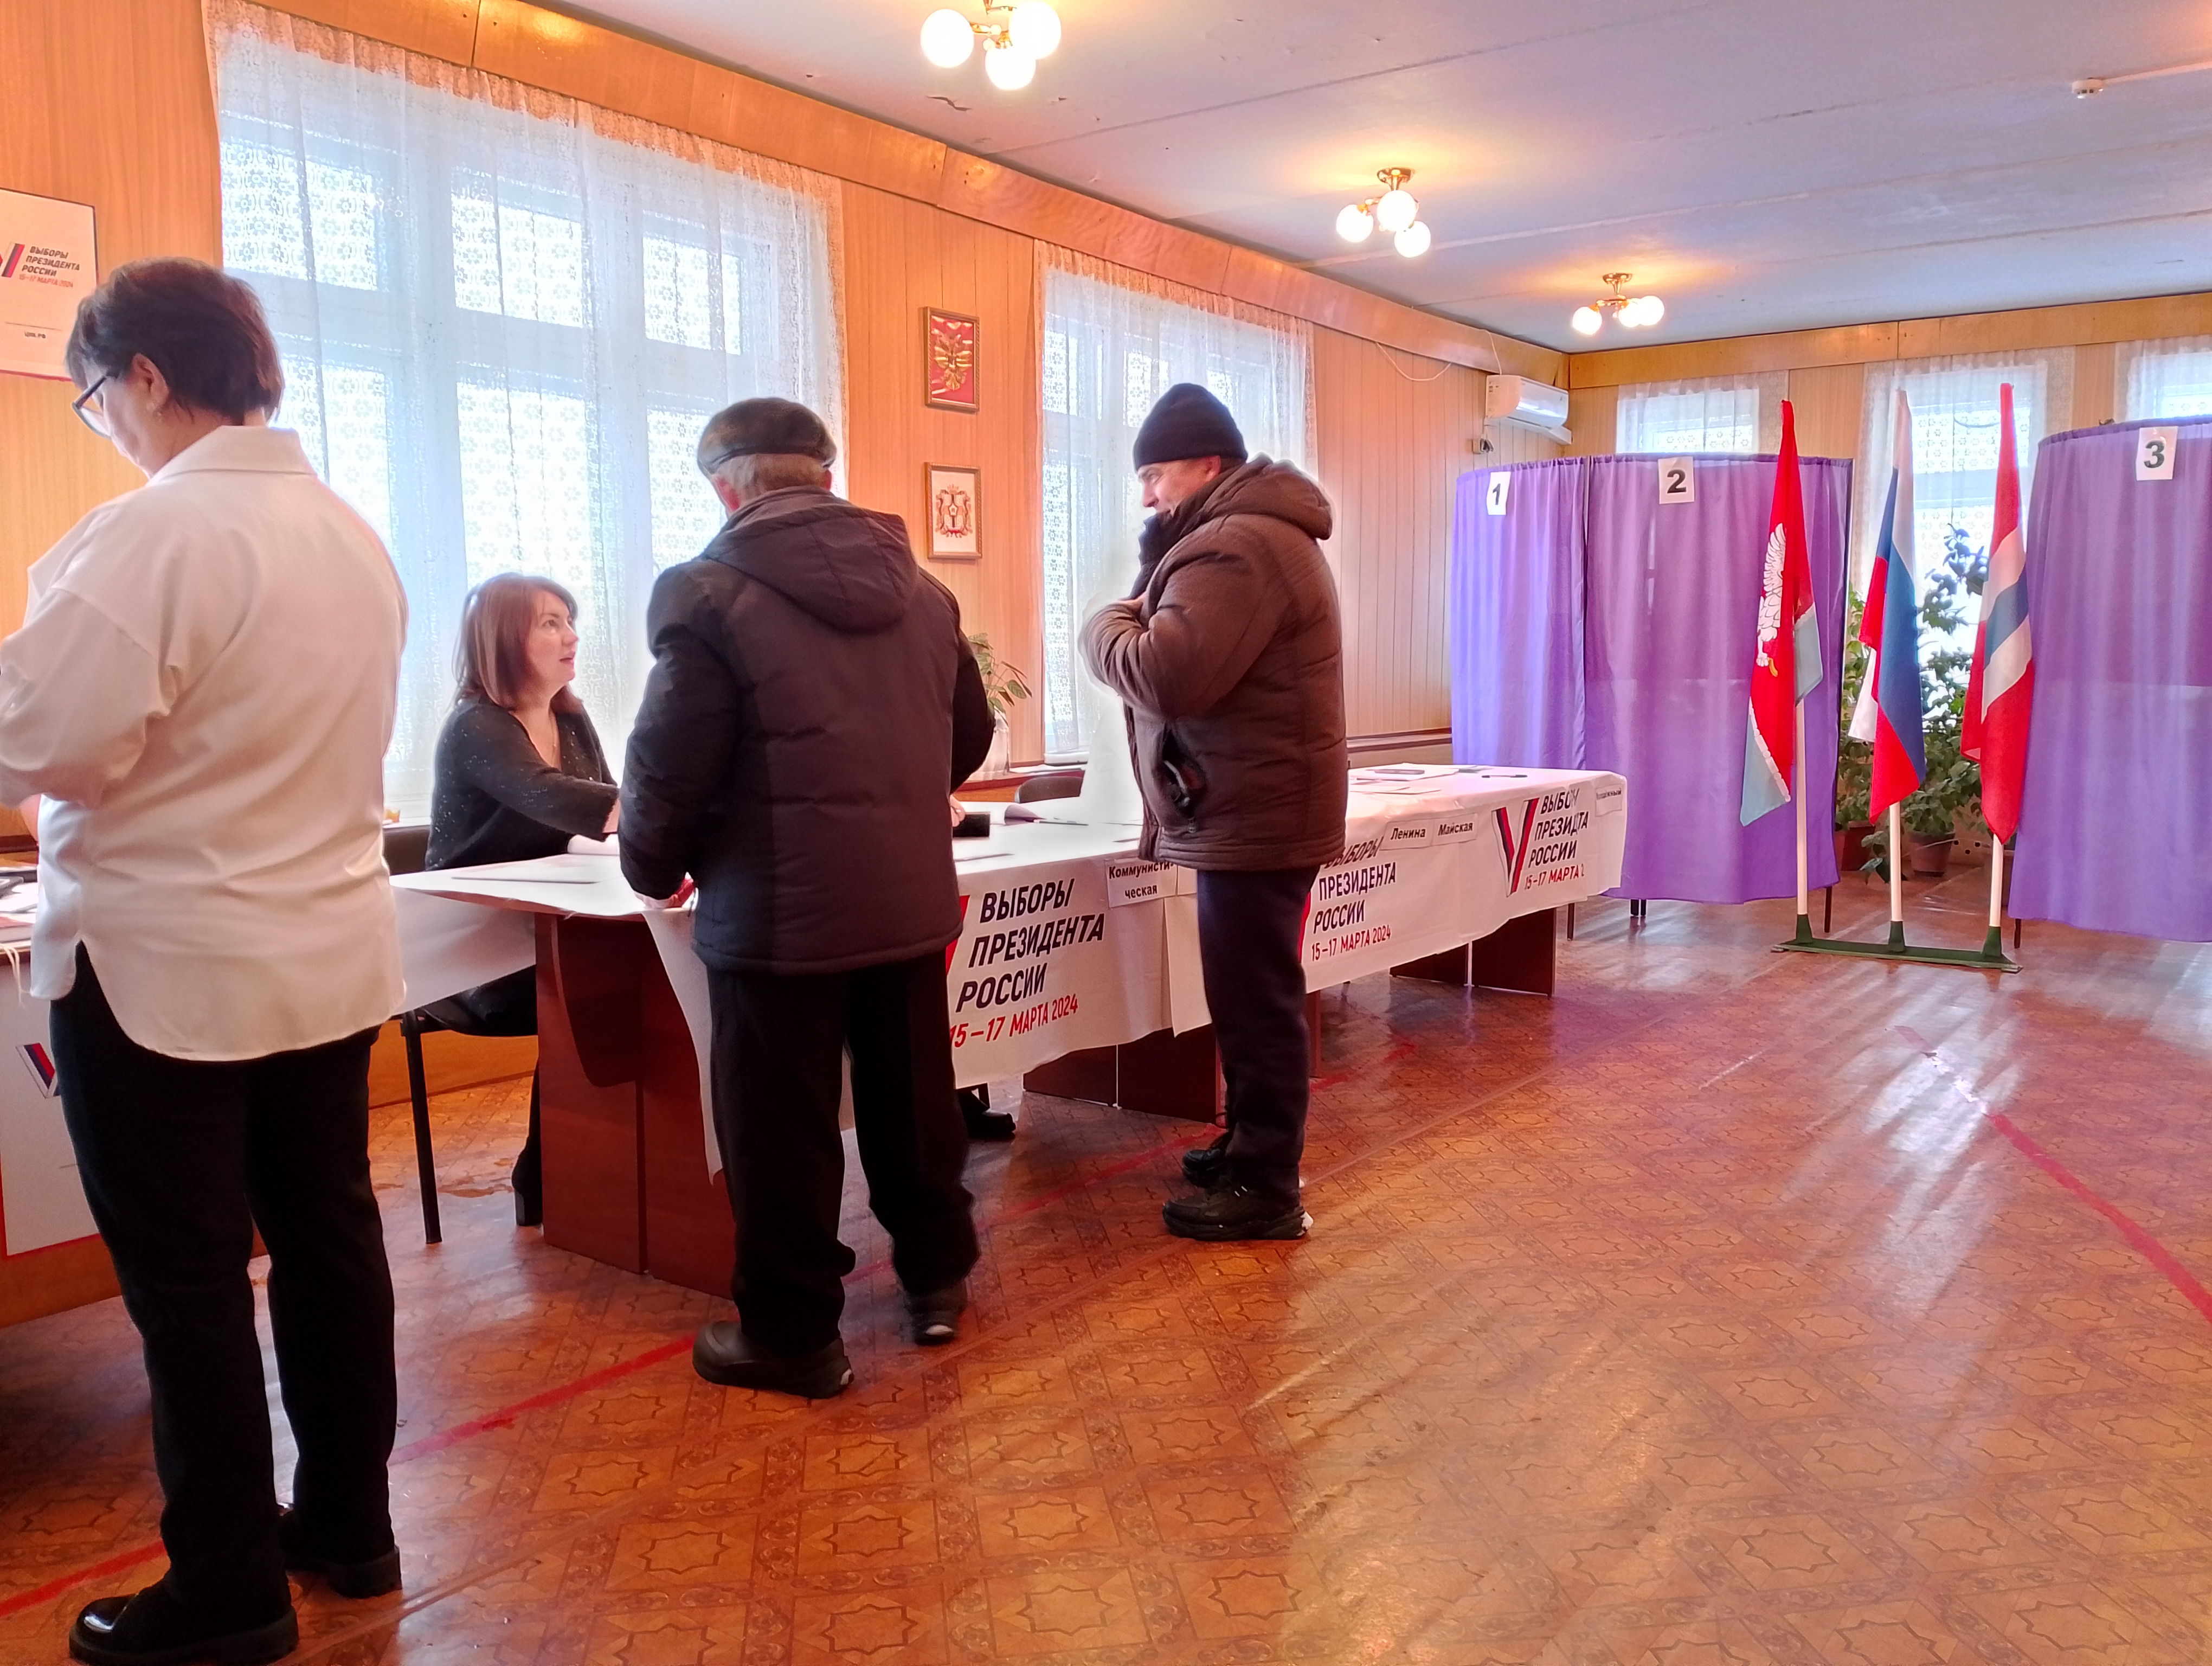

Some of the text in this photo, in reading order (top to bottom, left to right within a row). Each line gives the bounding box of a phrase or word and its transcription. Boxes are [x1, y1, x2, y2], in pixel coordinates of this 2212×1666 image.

[25, 255, 80, 271] ПРЕЗИДЕНТА
[30, 246, 69, 259] ВЫБОРЫ
[22, 265, 57, 277] РОССИИ
[2144, 440, 2165, 468] 3
[1492, 483, 1501, 505] 1
[1667, 469, 1687, 494] 2
[1540, 788, 1580, 815] ВЫБО
[1391, 822, 1473, 841] Ленина Майская
[1528, 840, 1577, 868] РОССИИ
[1109, 861, 1174, 879] Коммунисти-
[1319, 862, 1396, 901] ПРЕЗИДЕНТА
[1548, 864, 1579, 884] МАРТА
[980, 878, 1075, 923] ВЫБОРЫ
[1125, 885, 1158, 899] ческая
[1314, 900, 1365, 934] РОССИИ
[968, 913, 1104, 968] ПРЕЗИДЕНТА
[1340, 930, 1370, 953] МАРТА
[1372, 925, 1391, 944] 2024
[955, 963, 1047, 1013] РОССИИ
[1009, 1003, 1049, 1037] МАРТА
[1051, 994, 1078, 1021] 2024
